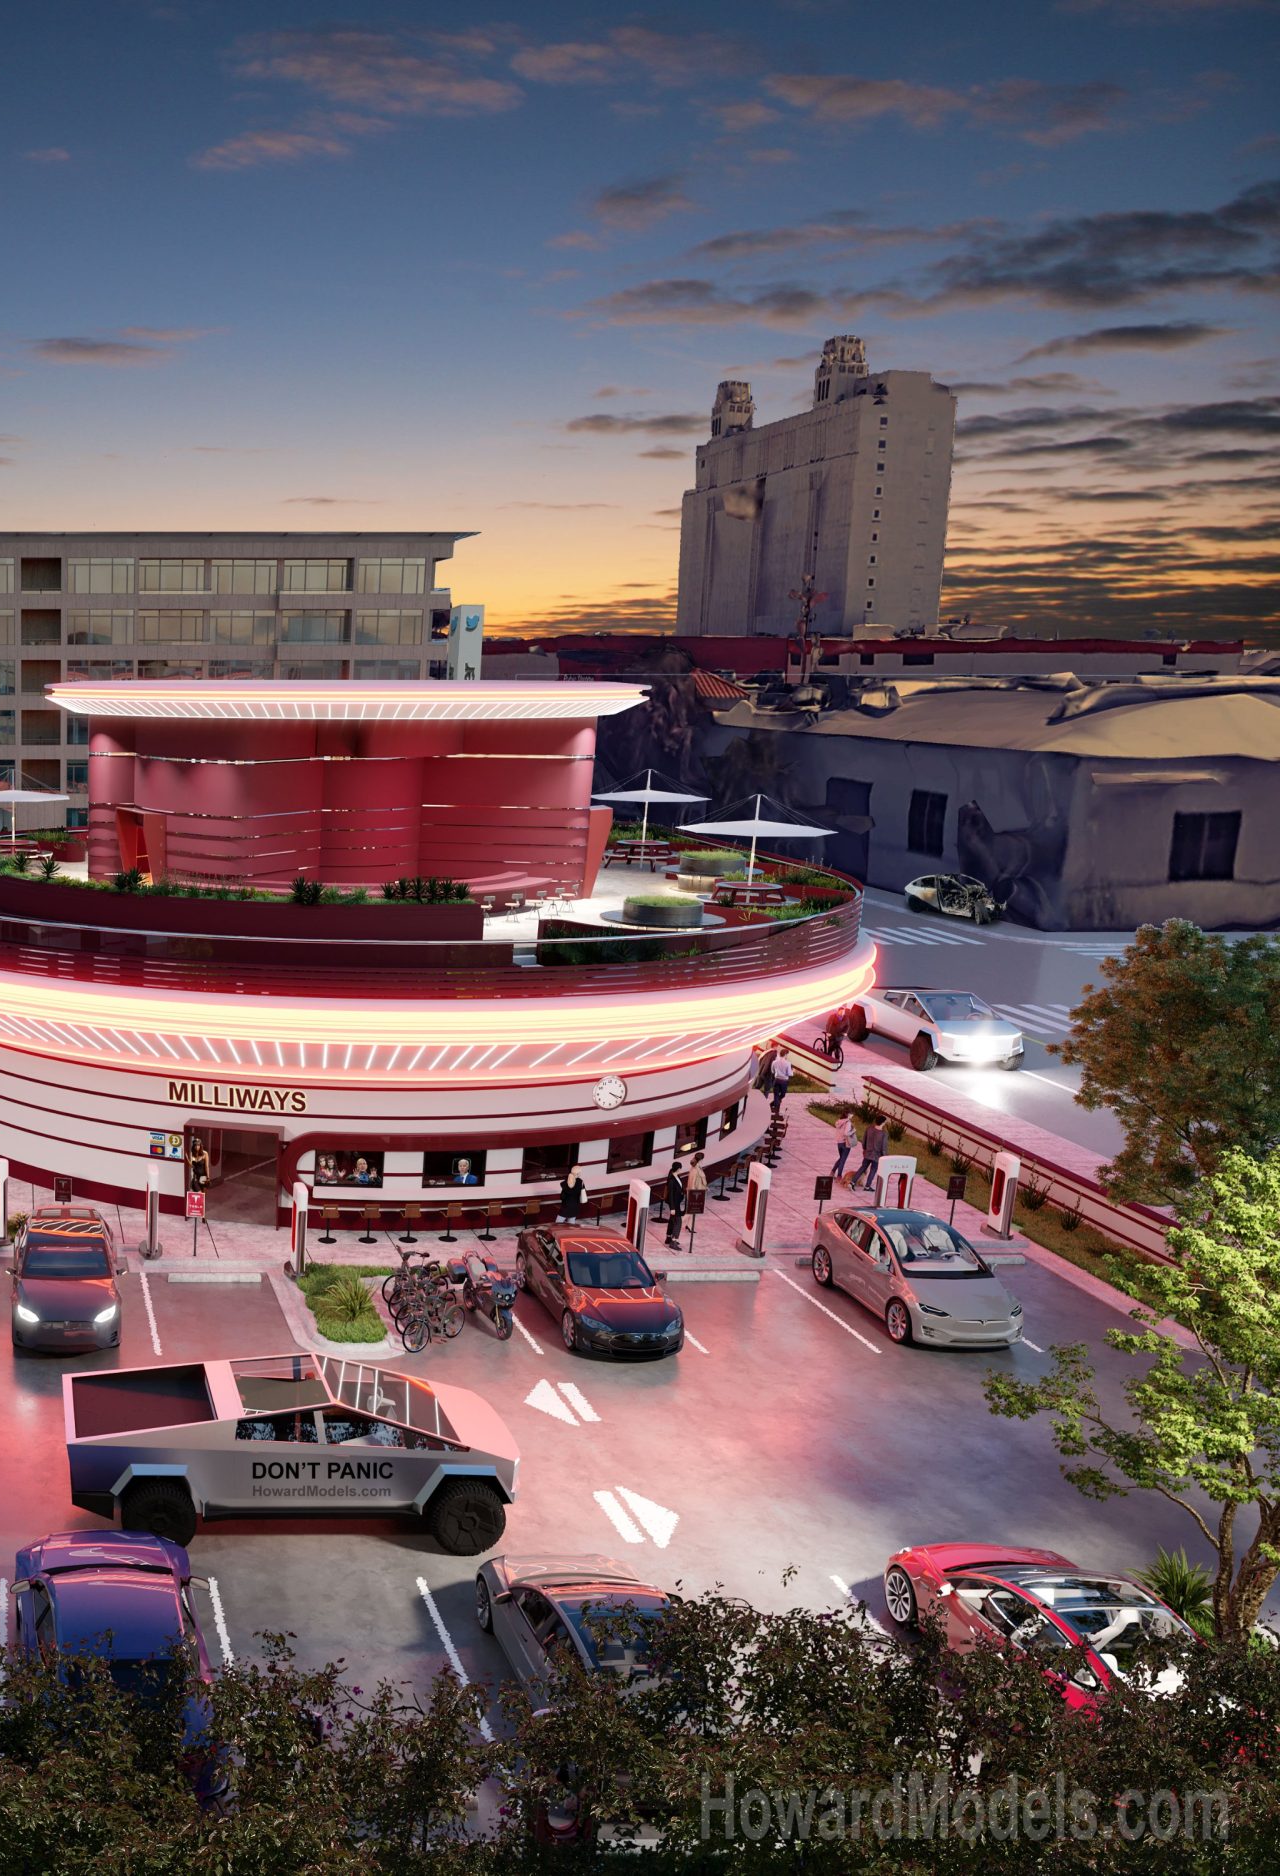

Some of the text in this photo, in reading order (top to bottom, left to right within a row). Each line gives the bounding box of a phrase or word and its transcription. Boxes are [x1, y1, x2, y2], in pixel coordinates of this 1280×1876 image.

[168, 1080, 307, 1113] MILLIWAYS
[252, 1462, 394, 1479] DON'T PANIC
[252, 1485, 391, 1498] HowardModels.com
